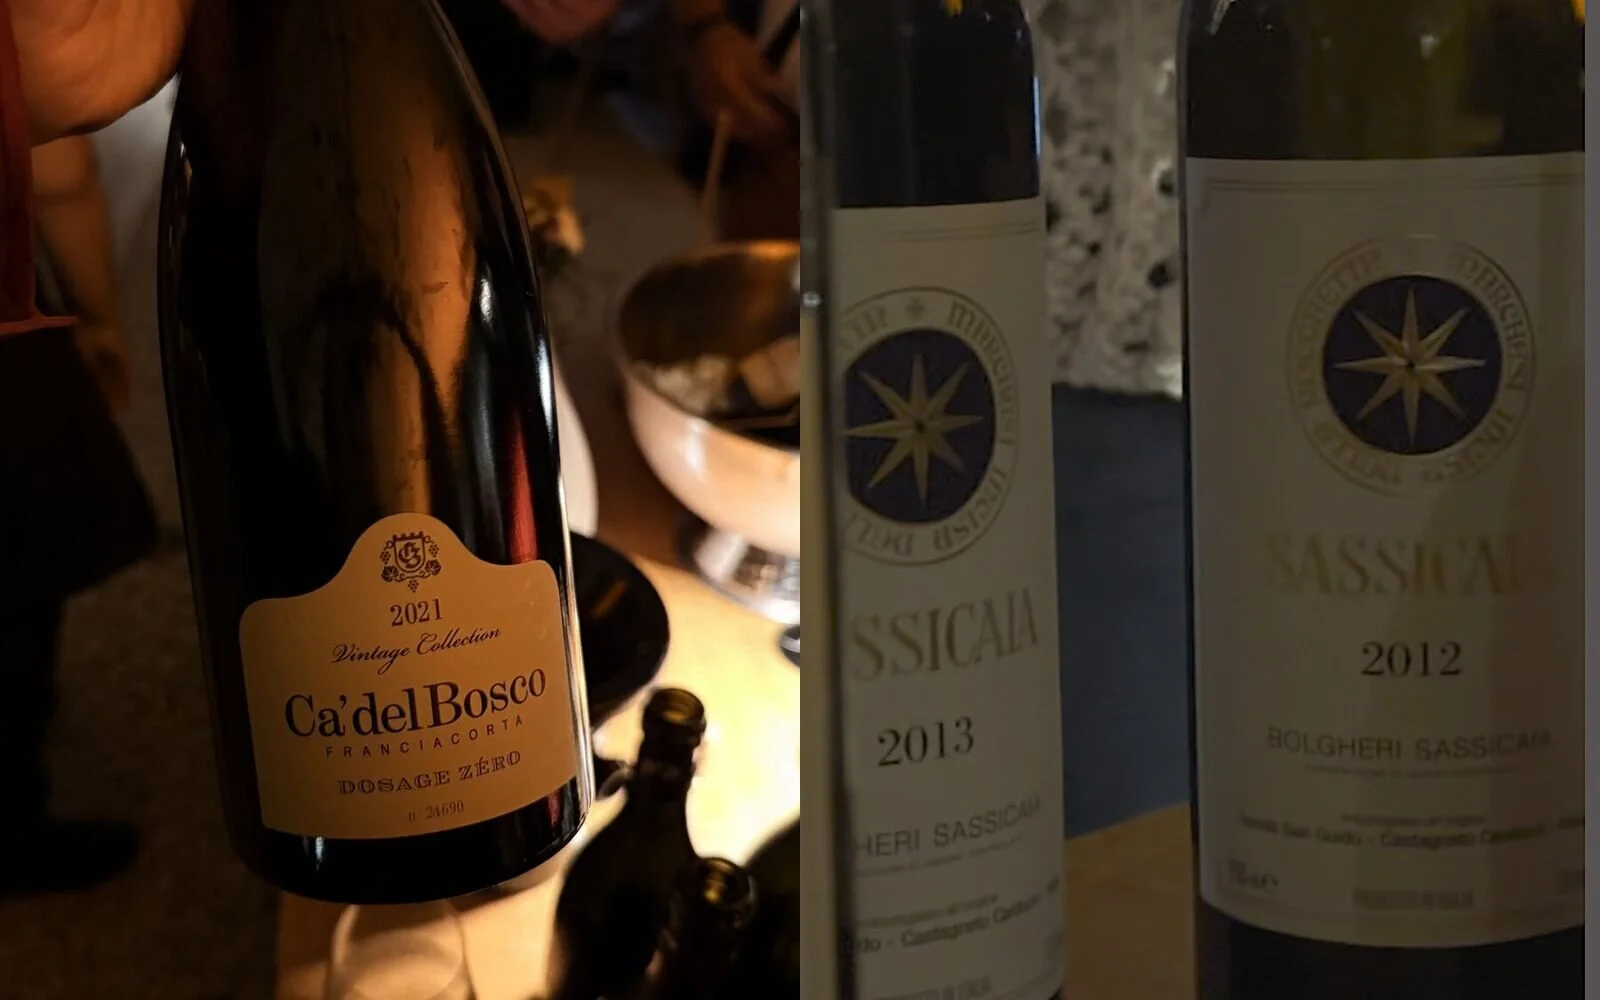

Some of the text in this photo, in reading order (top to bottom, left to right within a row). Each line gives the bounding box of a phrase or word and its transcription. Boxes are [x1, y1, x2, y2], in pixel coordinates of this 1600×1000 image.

[390, 598, 443, 627] 2021
[331, 626, 502, 675] Vintage Collection
[1360, 641, 1463, 677] 2012
[423, 668, 547, 729] Bosco
[326, 714, 524, 758] FRANCIACORTA
[876, 715, 975, 767] 2013
[1267, 726, 1402, 761] BOLGHERI
[338, 750, 523, 795] DOSAGE ZÉRO
